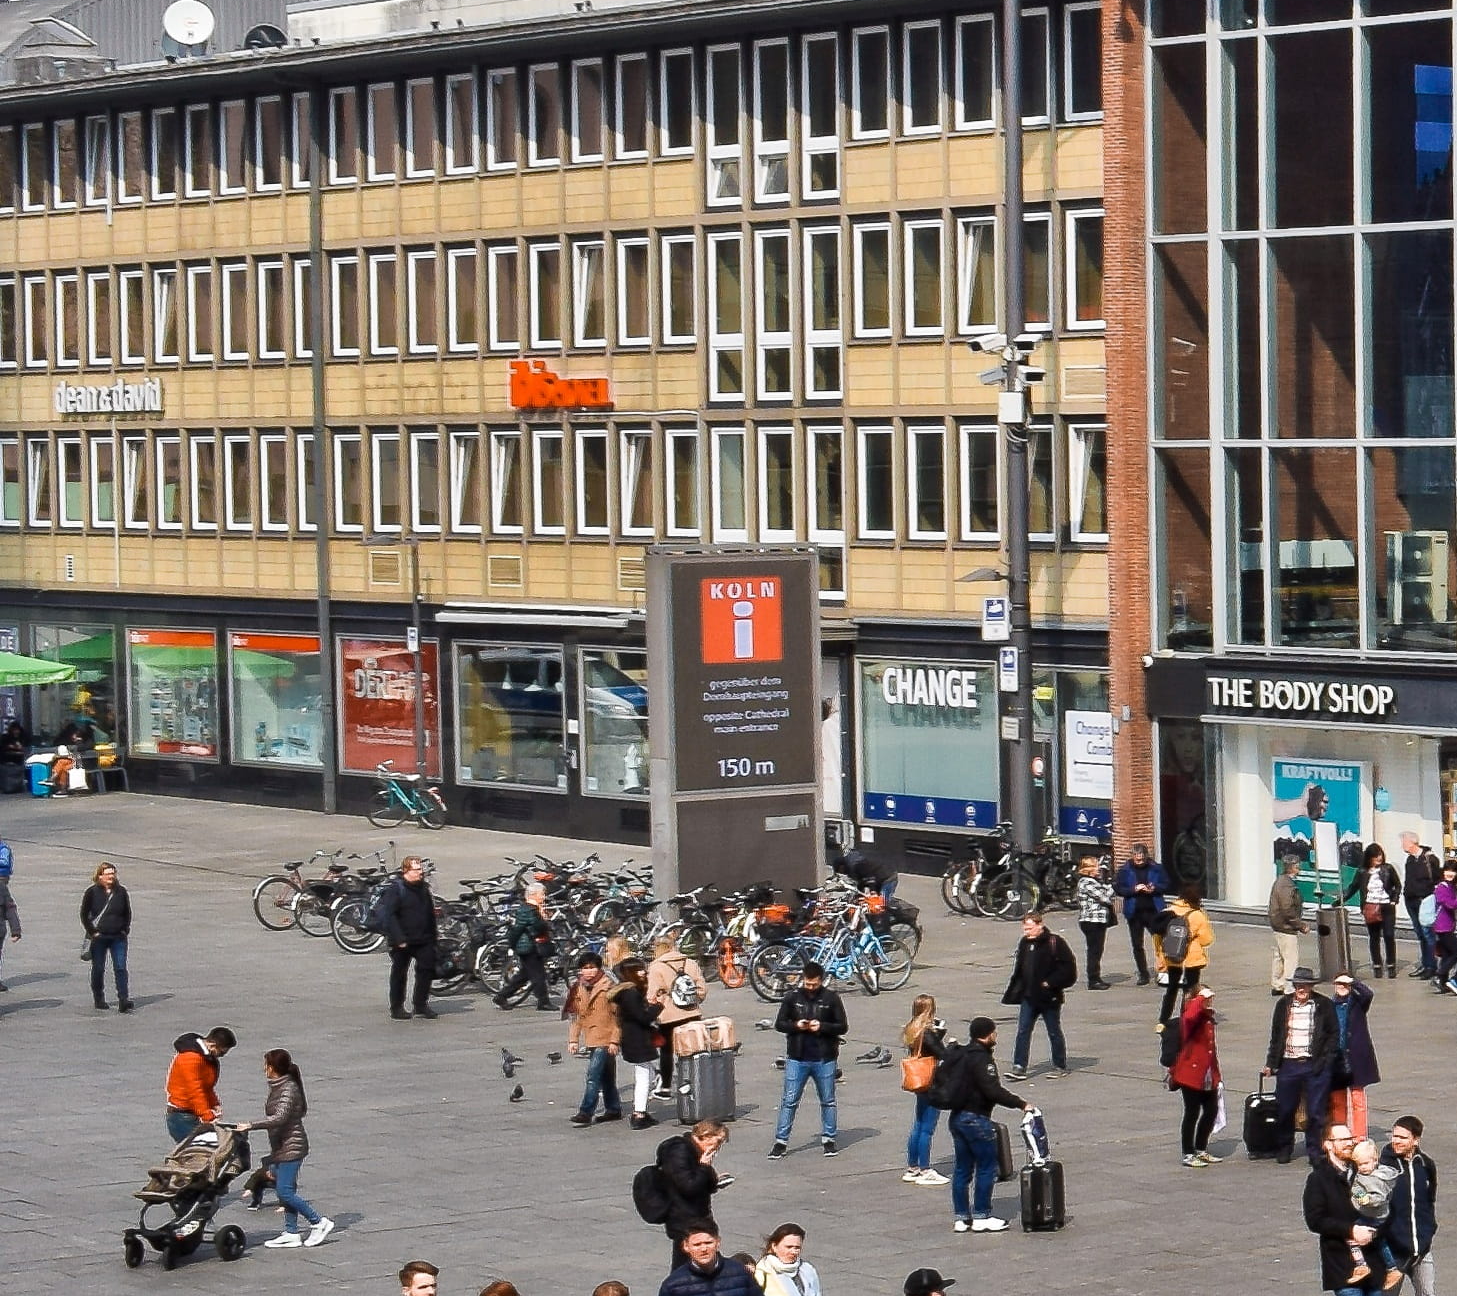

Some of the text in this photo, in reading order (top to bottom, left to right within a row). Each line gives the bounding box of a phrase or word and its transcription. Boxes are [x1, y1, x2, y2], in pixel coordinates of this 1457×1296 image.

[882, 667, 977, 708] CHANGE
[1207, 677, 1394, 715] THE BODY SHOP
[717, 757, 774, 778] 150 m
[1281, 764, 1353, 782] KRAFTVOLL!
